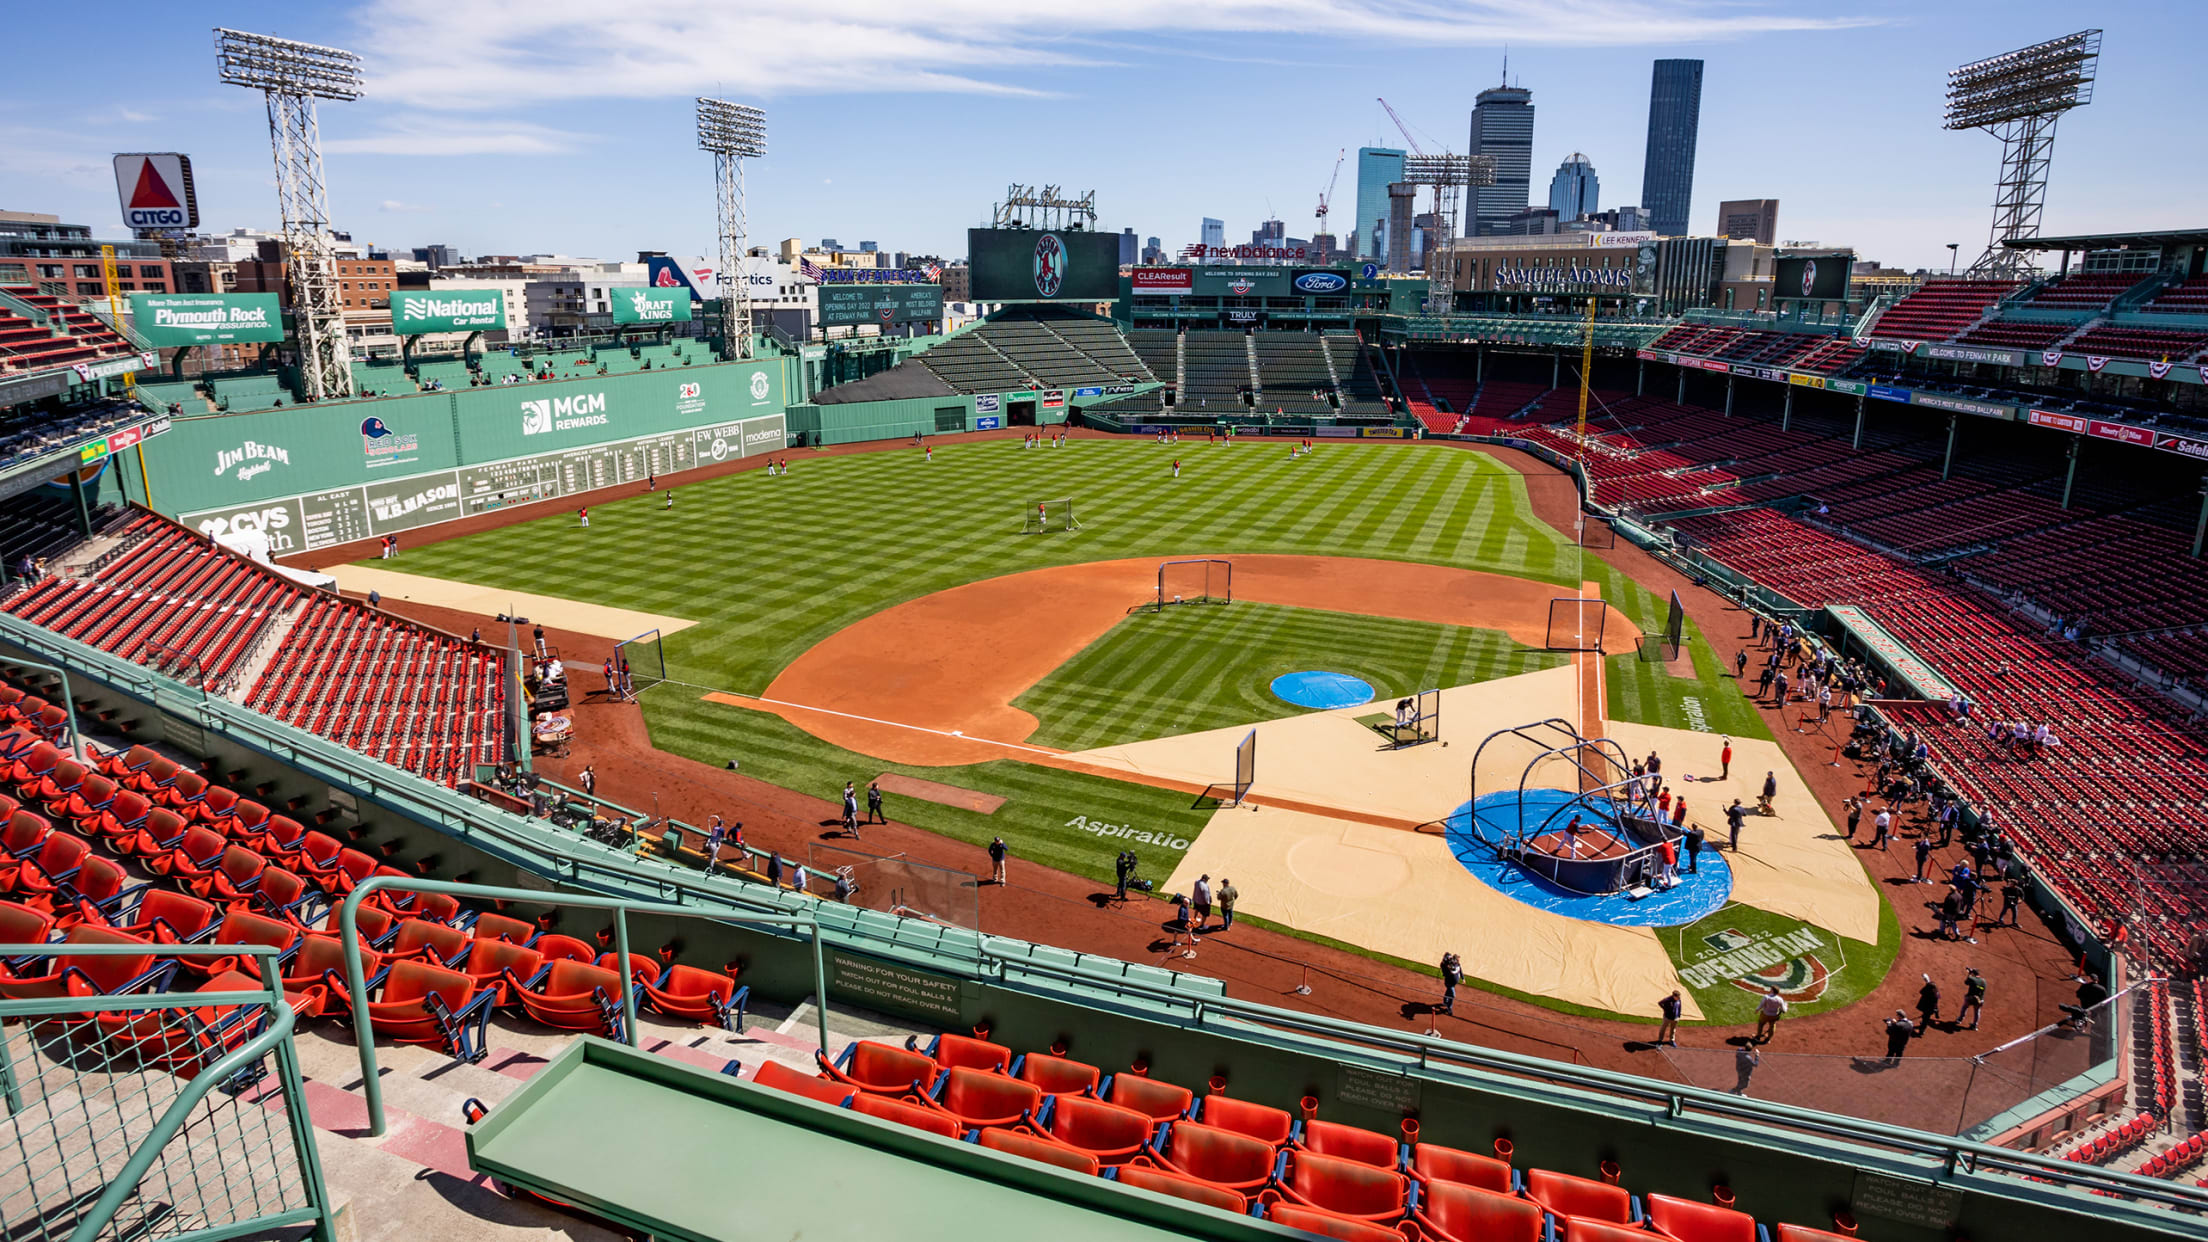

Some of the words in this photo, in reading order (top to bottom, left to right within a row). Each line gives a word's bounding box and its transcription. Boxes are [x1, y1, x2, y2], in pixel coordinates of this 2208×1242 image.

[131, 210, 183, 225] CITGO
[1602, 236, 1615, 244] LEE
[1210, 247, 1240, 258] new
[1241, 244, 1305, 259] balance
[822, 270, 855, 281] BANK
[857, 270, 873, 281] OF
[873, 270, 922, 281] AMERICA
[1138, 272, 1186, 280] CLEAResult
[1304, 276, 1336, 290] Ford
[1495, 266, 1564, 287] SAMUEL
[1569, 265, 1632, 287] ADAMS
[635, 300, 674, 313] DRAFT
[858, 302, 870, 310] 2022
[156, 308, 226, 326] Plymouth
[230, 307, 266, 322] Rock
[453, 317, 468, 326] Car
[470, 316, 496, 325] Rental
[640, 310, 672, 320] KINGS
[836, 312, 856, 320] FENWAY
[1928, 348, 1955, 358] WELCOME
[1957, 350, 1964, 358] TO
[1966, 351, 1991, 362] FENWAY
[1992, 352, 2012, 362] PARK
[554, 393, 606, 415] MGM
[1919, 397, 1941, 406] AMERICA'S
[1942, 400, 1954, 409] MOST
[1955, 402, 1977, 412] BELOVED
[1977, 404, 2004, 416] BALLPARK
[556, 415, 607, 431] REWARDS
[714, 425, 740, 438] WEBB
[746, 428, 781, 442] moderna
[368, 443, 418, 456] SCHOLARS
[369, 436, 390, 449] RED
[394, 434, 418, 445] SOX
[214, 447, 244, 476] JIM
[244, 441, 290, 465] BEAM
[478, 464, 512, 473] FENWAY
[330, 492, 350, 500] EAST
[230, 507, 289, 535] CVS
[1064, 815, 1190, 850] Aspiratio
[1696, 949, 1717, 960] 20
[1752, 930, 1772, 940] 22
[1678, 942, 1786, 989] OPENING
[1770, 928, 1824, 957] DAY
[834, 956, 874, 974] WARNING:
[876, 968, 894, 978] FOR
[896, 972, 921, 986] YOUR
[922, 979, 957, 992] SAFETY
[841, 970, 864, 982] WATCH
[865, 976, 881, 986] OUT
[882, 980, 898, 990] FOR
[900, 985, 920, 996] FOUL
[920, 990, 946, 1000] BALLS
[835, 980, 863, 992] PLEASE
[864, 986, 876, 994] DO
[876, 990, 891, 998] NOT
[892, 994, 918, 1005] REACH
[919, 1000, 940, 1010] OVER
[942, 1005, 960, 1016] RAIL
[1346, 1070, 1373, 1079] WATCH
[1376, 1075, 1393, 1084] OUT
[1396, 1079, 1414, 1088] FOR
[1348, 1078, 1370, 1087] FOUL
[1374, 1083, 1401, 1092] BALLS
[1340, 1091, 1369, 1102] REACH
[1372, 1098, 1394, 1108] OVER
[1345, 1084, 1377, 1096] PLEASE
[1380, 1092, 1392, 1100] DO
[1395, 1095, 1412, 1104] NOT
[1866, 1176, 1900, 1188] WATCH
[1903, 1184, 1926, 1193] OUT
[1929, 1189, 1952, 1198] FOR
[1868, 1184, 1897, 1197] FOUL
[1901, 1192, 1935, 1204] BALLS
[1863, 1193, 1904, 1208] PLEASE
[1907, 1202, 1924, 1210] DO
[1927, 1207, 1950, 1216] NOT
[1856, 1201, 1892, 1213] REACH
[1896, 1210, 1926, 1220] OVER
[1929, 1216, 1952, 1227] RAIL
